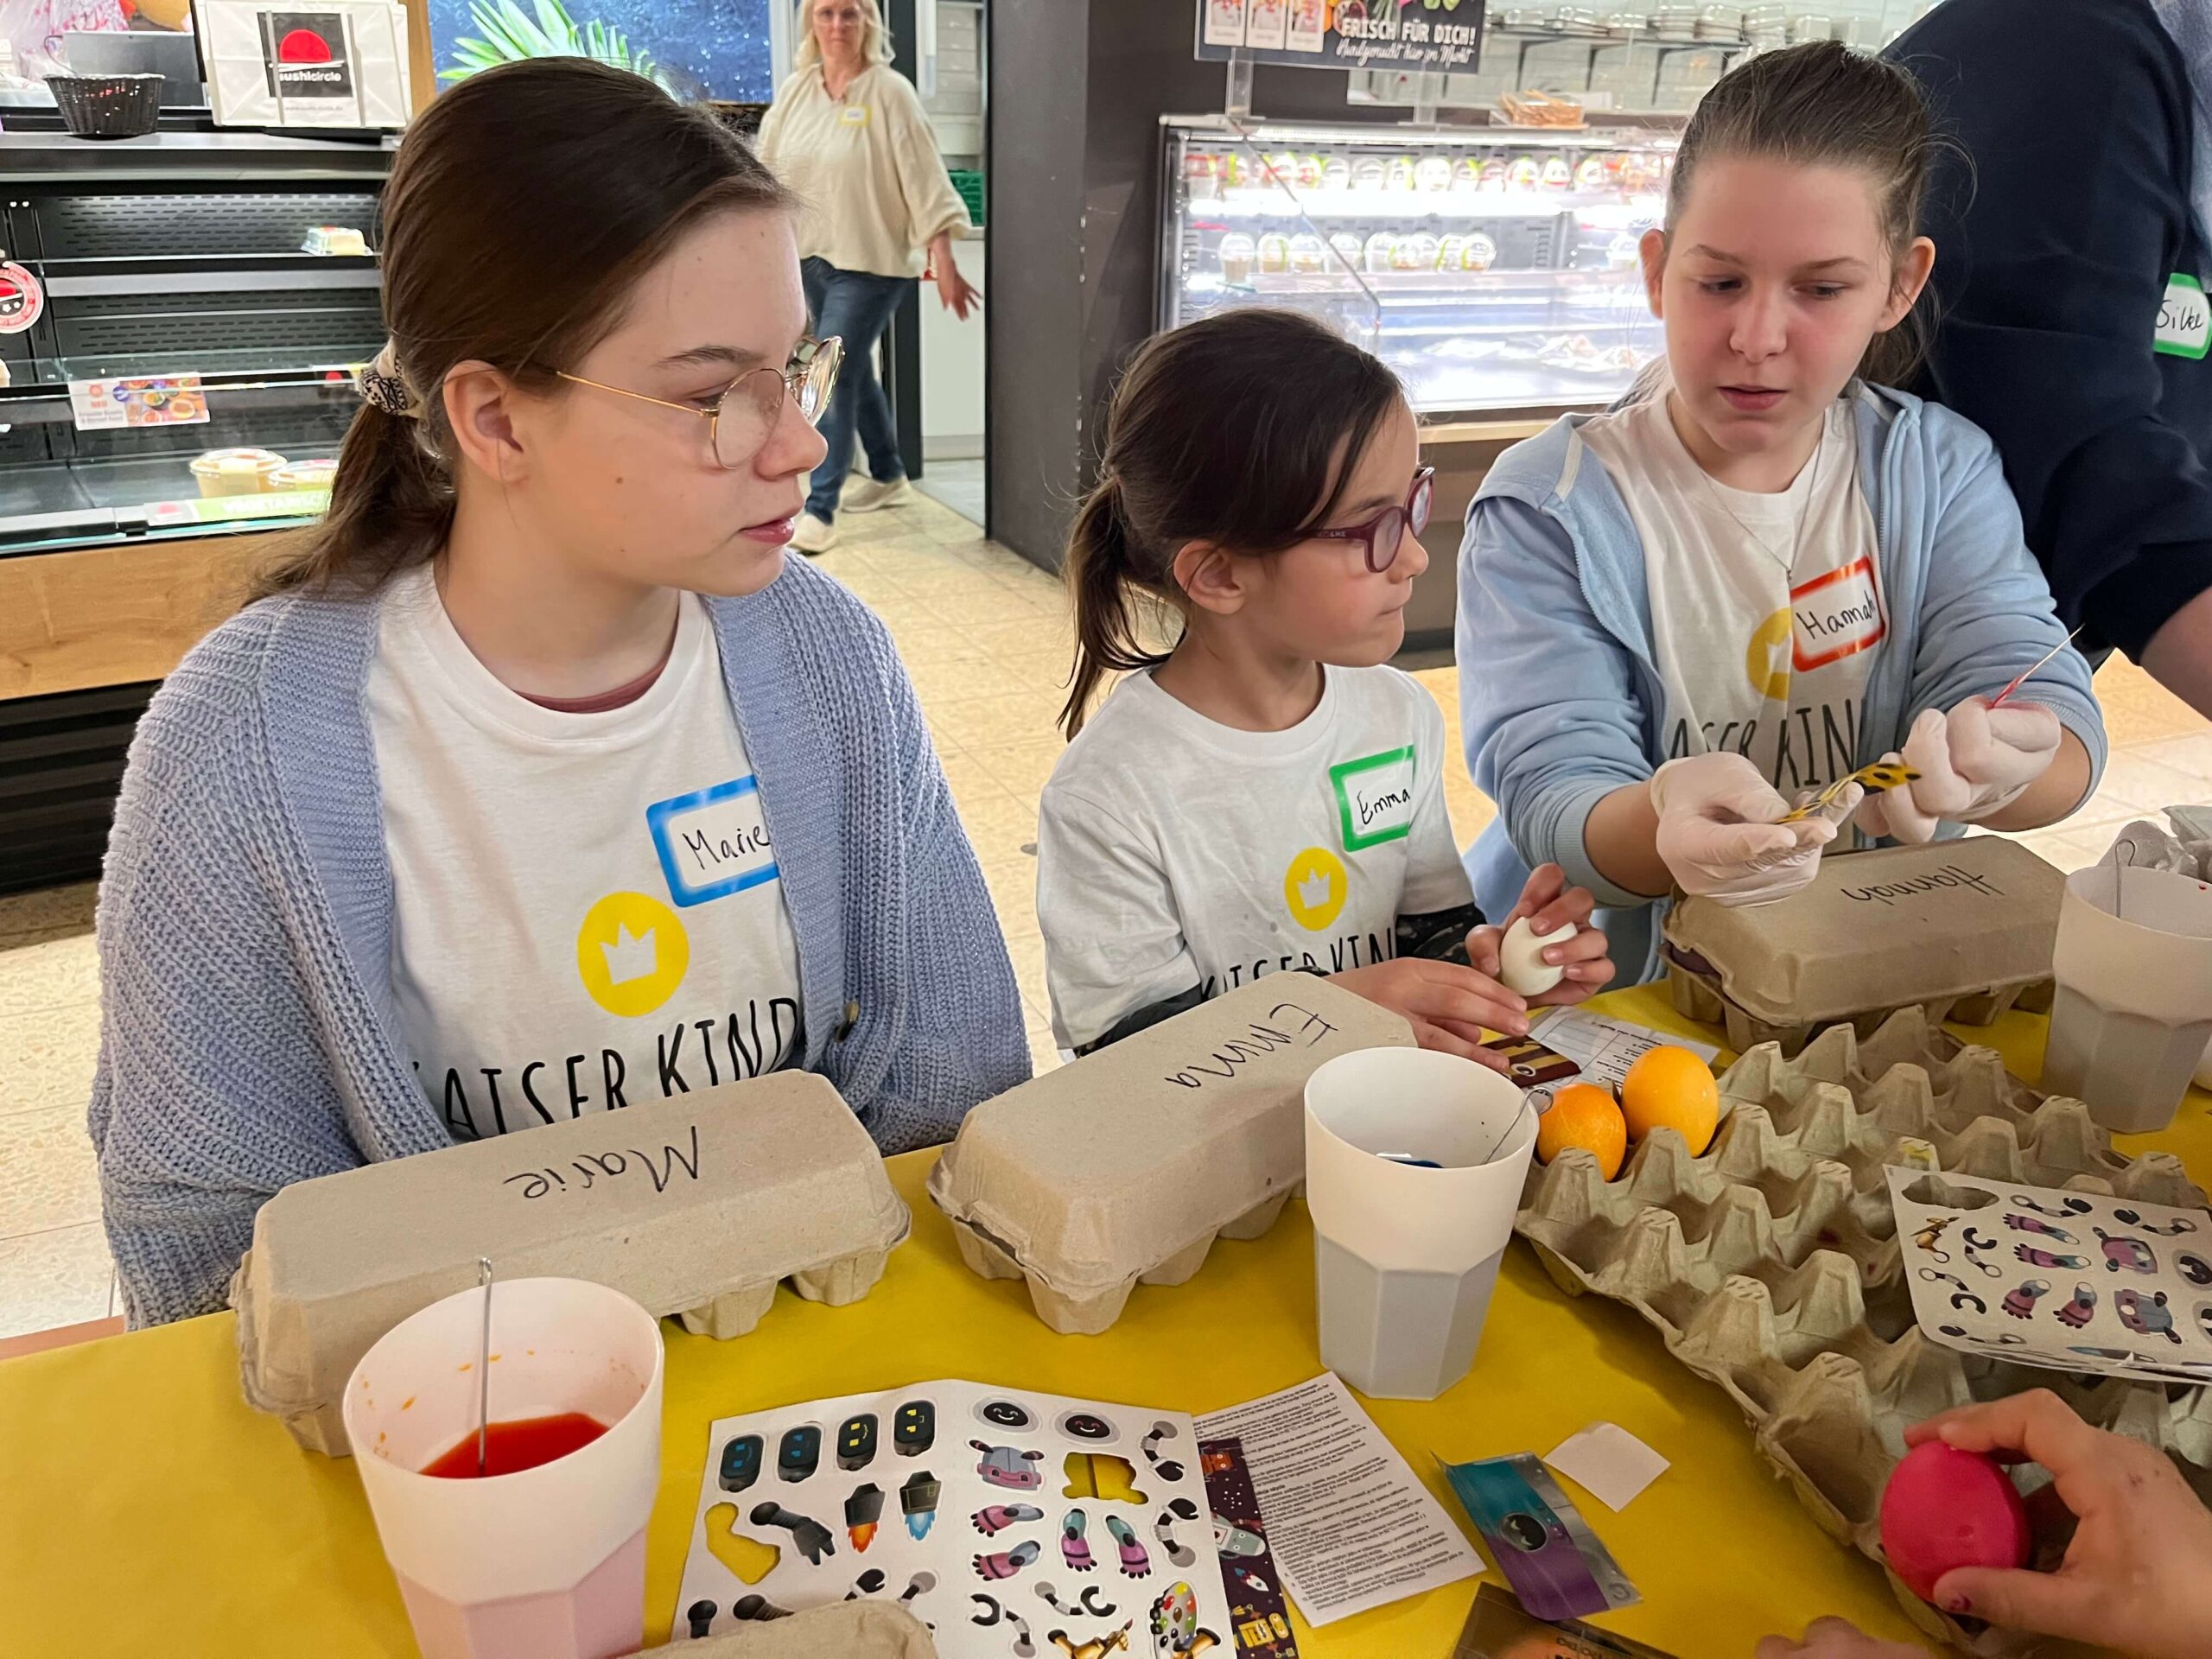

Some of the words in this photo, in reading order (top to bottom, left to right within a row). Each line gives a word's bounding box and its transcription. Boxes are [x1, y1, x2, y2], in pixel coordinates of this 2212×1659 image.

[1341, 17, 1397, 41] FRISCH
[1402, 18, 1430, 43] FÜR
[1433, 23, 1477, 46] DICH!
[1357, 790, 1410, 824] Emma
[682, 825, 771, 870] Marie
[1840, 865, 2005, 906] Hannah
[1164, 1002, 1338, 1089] Emma
[413, 1049, 628, 1138] AISER
[503, 1126, 698, 1198] Marie
